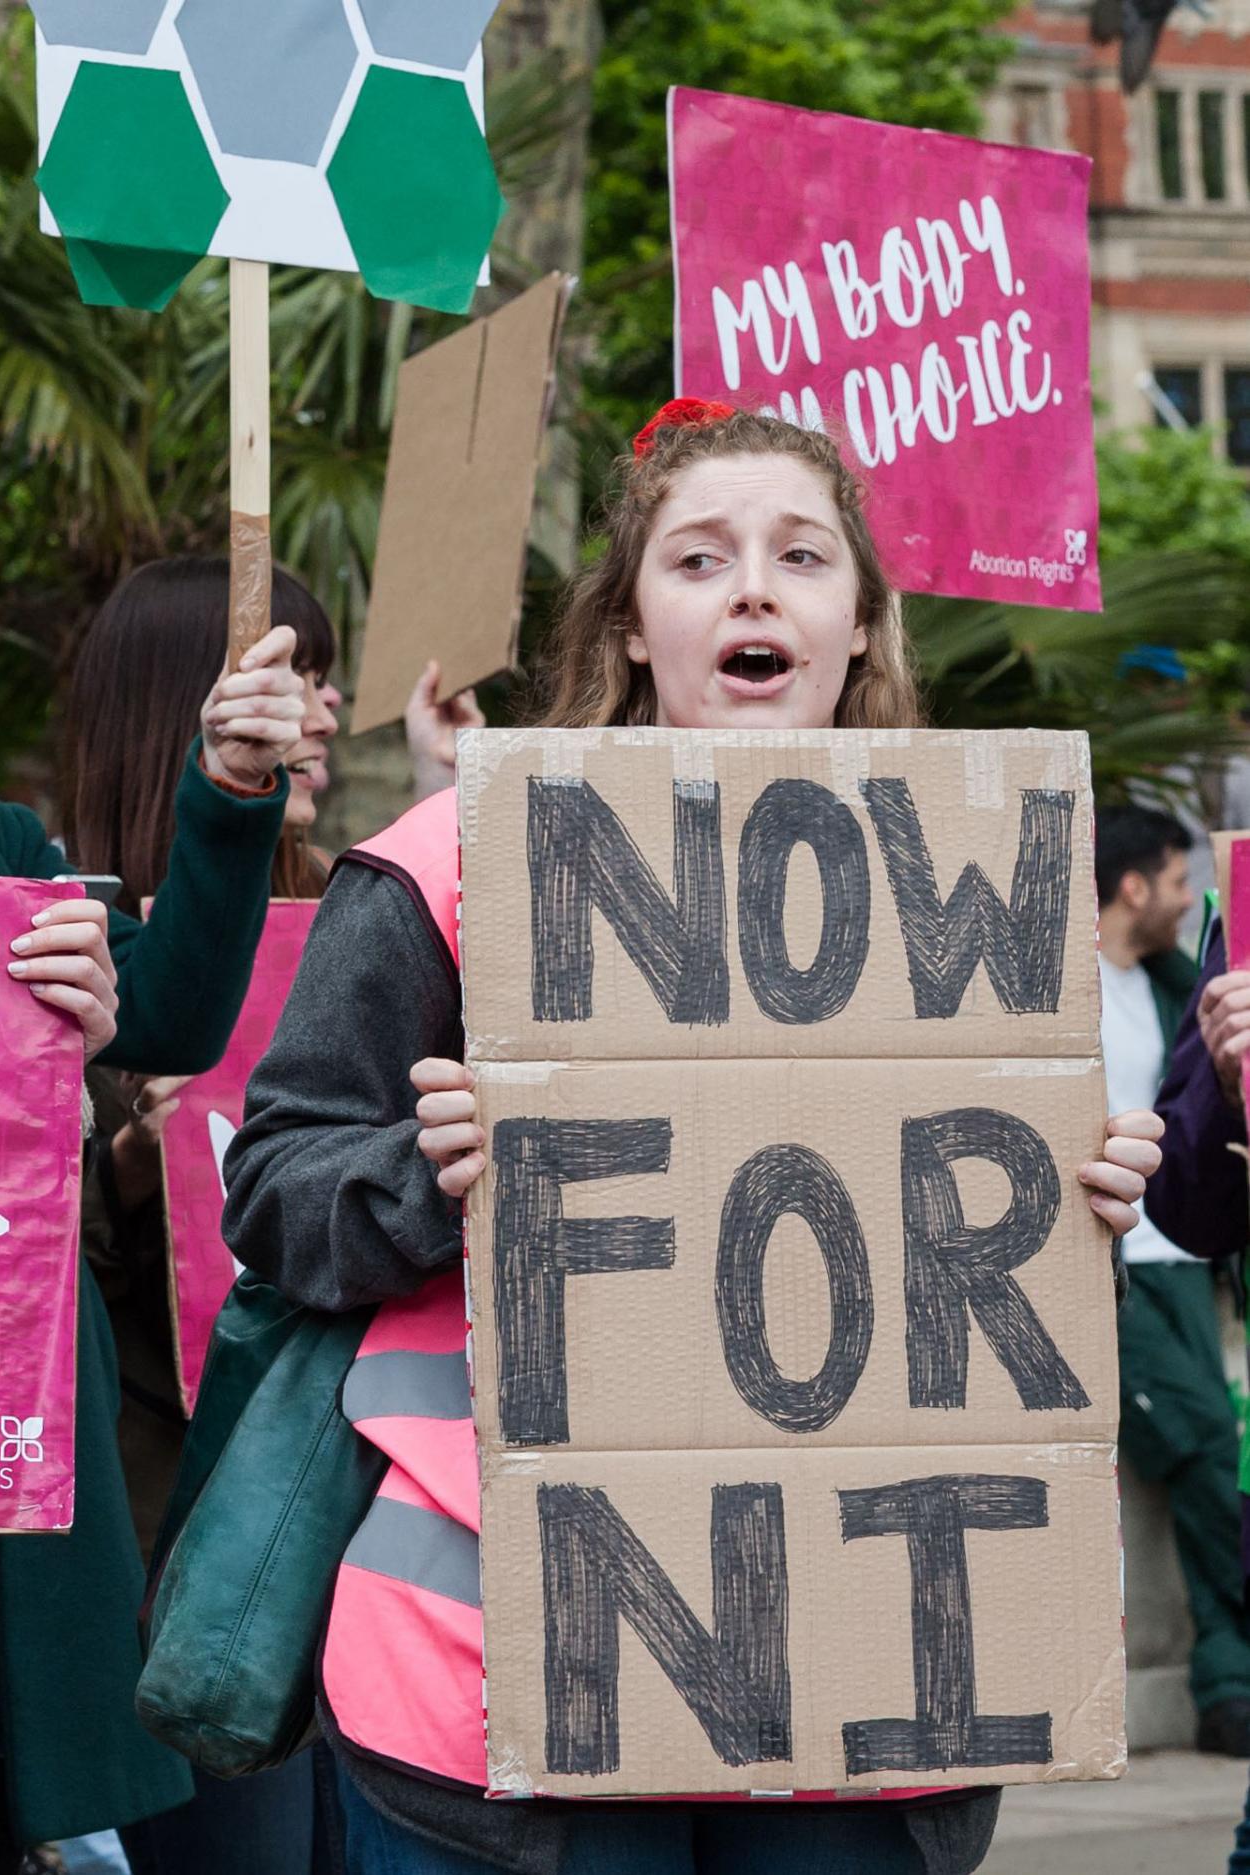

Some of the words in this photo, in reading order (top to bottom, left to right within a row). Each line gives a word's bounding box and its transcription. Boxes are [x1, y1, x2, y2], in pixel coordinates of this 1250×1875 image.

[711, 260, 821, 391] MY
[821, 195, 1026, 340] BODY.
[843, 310, 1063, 469] CHOICE.
[969, 549, 1027, 578] Abortion
[1028, 556, 1075, 588] Rights
[526, 774, 1076, 1028] NOW
[492, 1106, 1092, 1448] FOR
[536, 1473, 1054, 1780] NI
